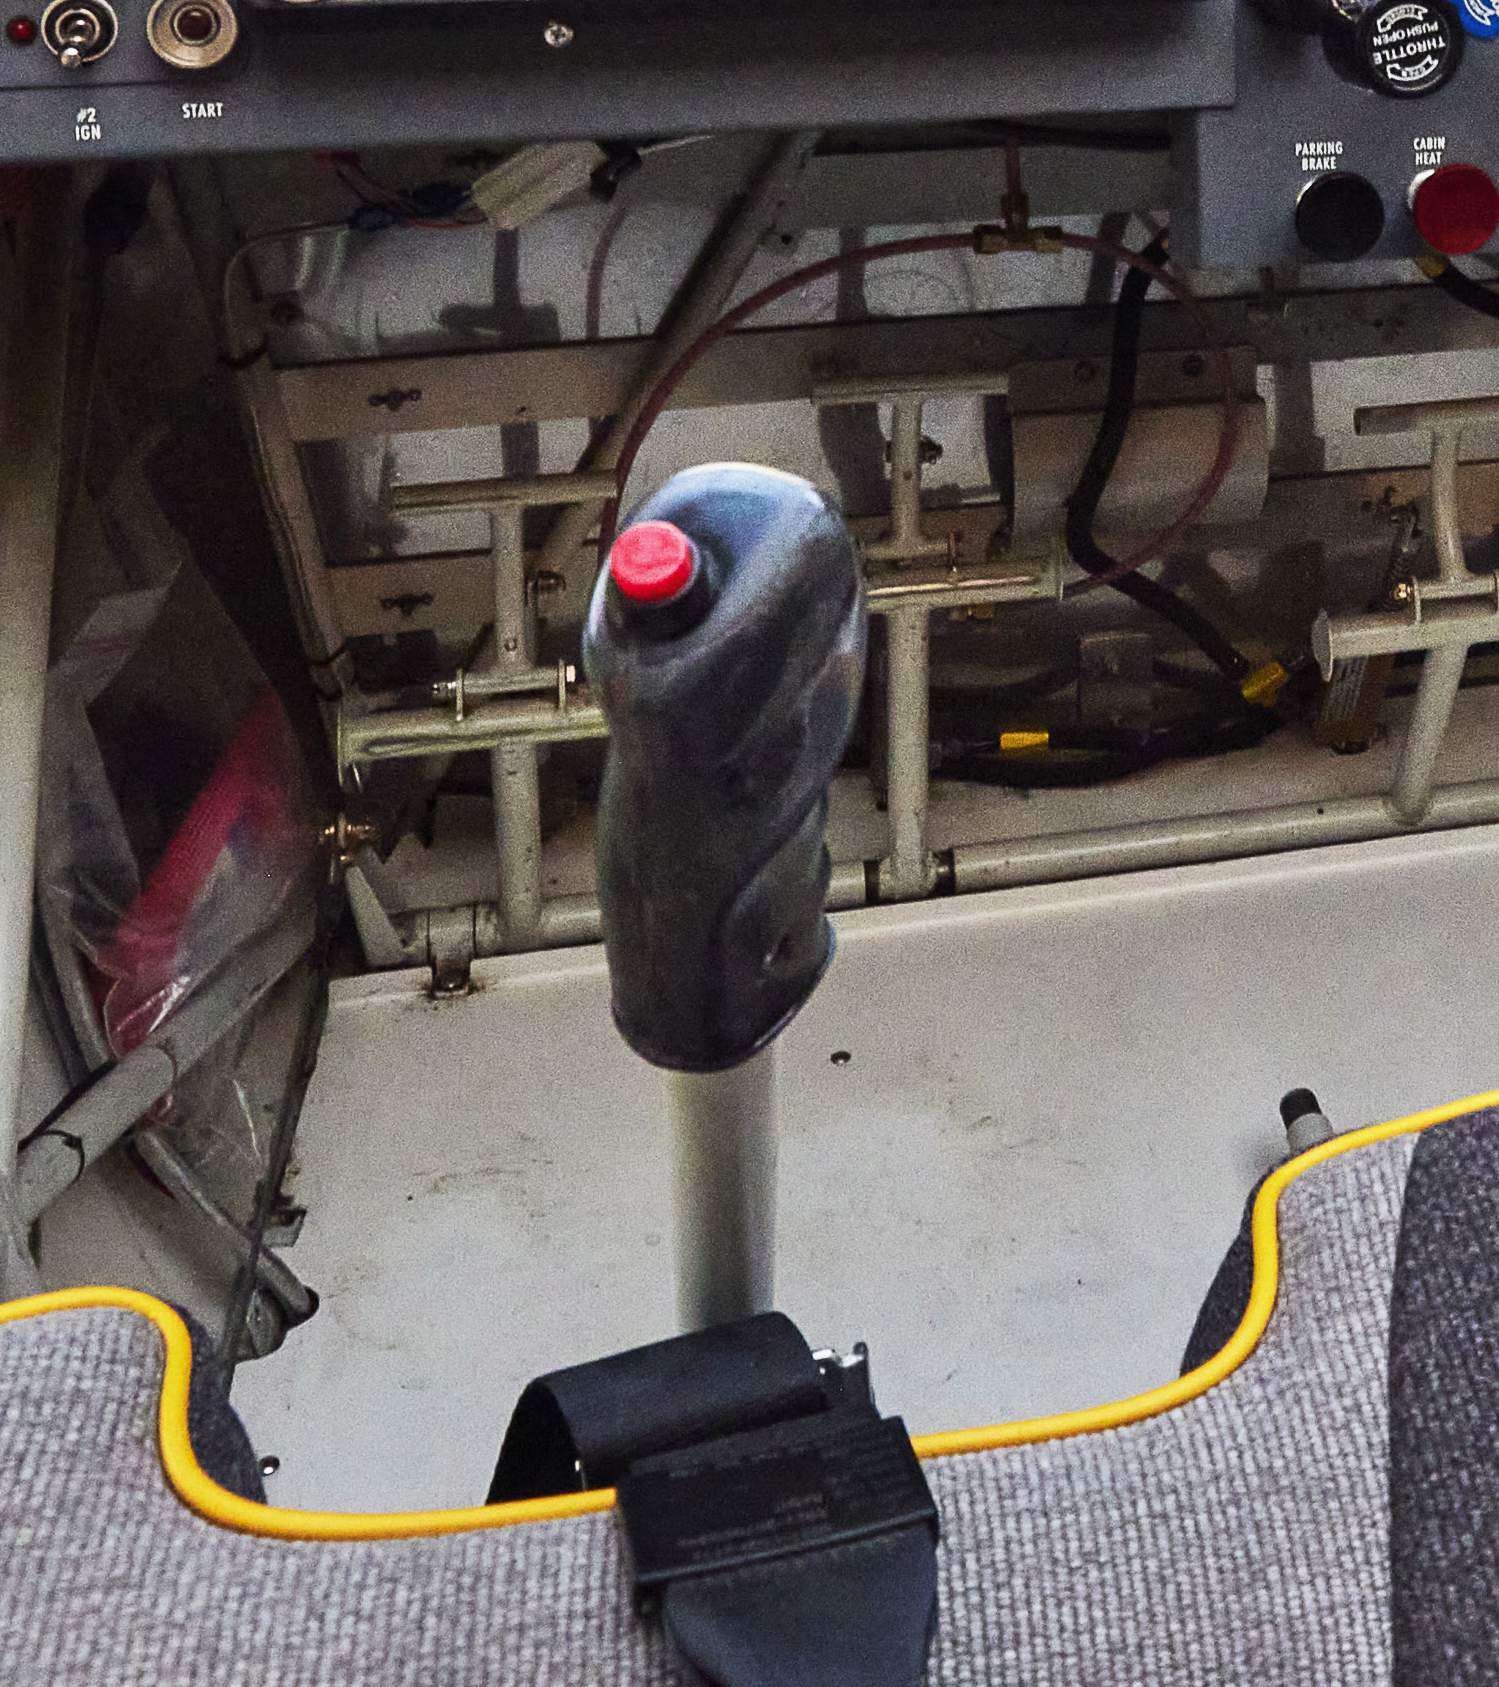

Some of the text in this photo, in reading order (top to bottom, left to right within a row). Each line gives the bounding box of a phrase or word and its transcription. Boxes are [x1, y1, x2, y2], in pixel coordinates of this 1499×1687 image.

[1373, 32, 1406, 47] OPEN
[1373, 36, 1446, 64] THROTTLE
[77, 108, 96, 123] #2
[182, 103, 223, 118] START
[75, 125, 101, 141] IGN
[1295, 141, 1343, 155] PARKING
[1413, 137, 1445, 151] CABIN
[1302, 157, 1336, 171] BRAKE
[1415, 152, 1442, 165] HEAT
